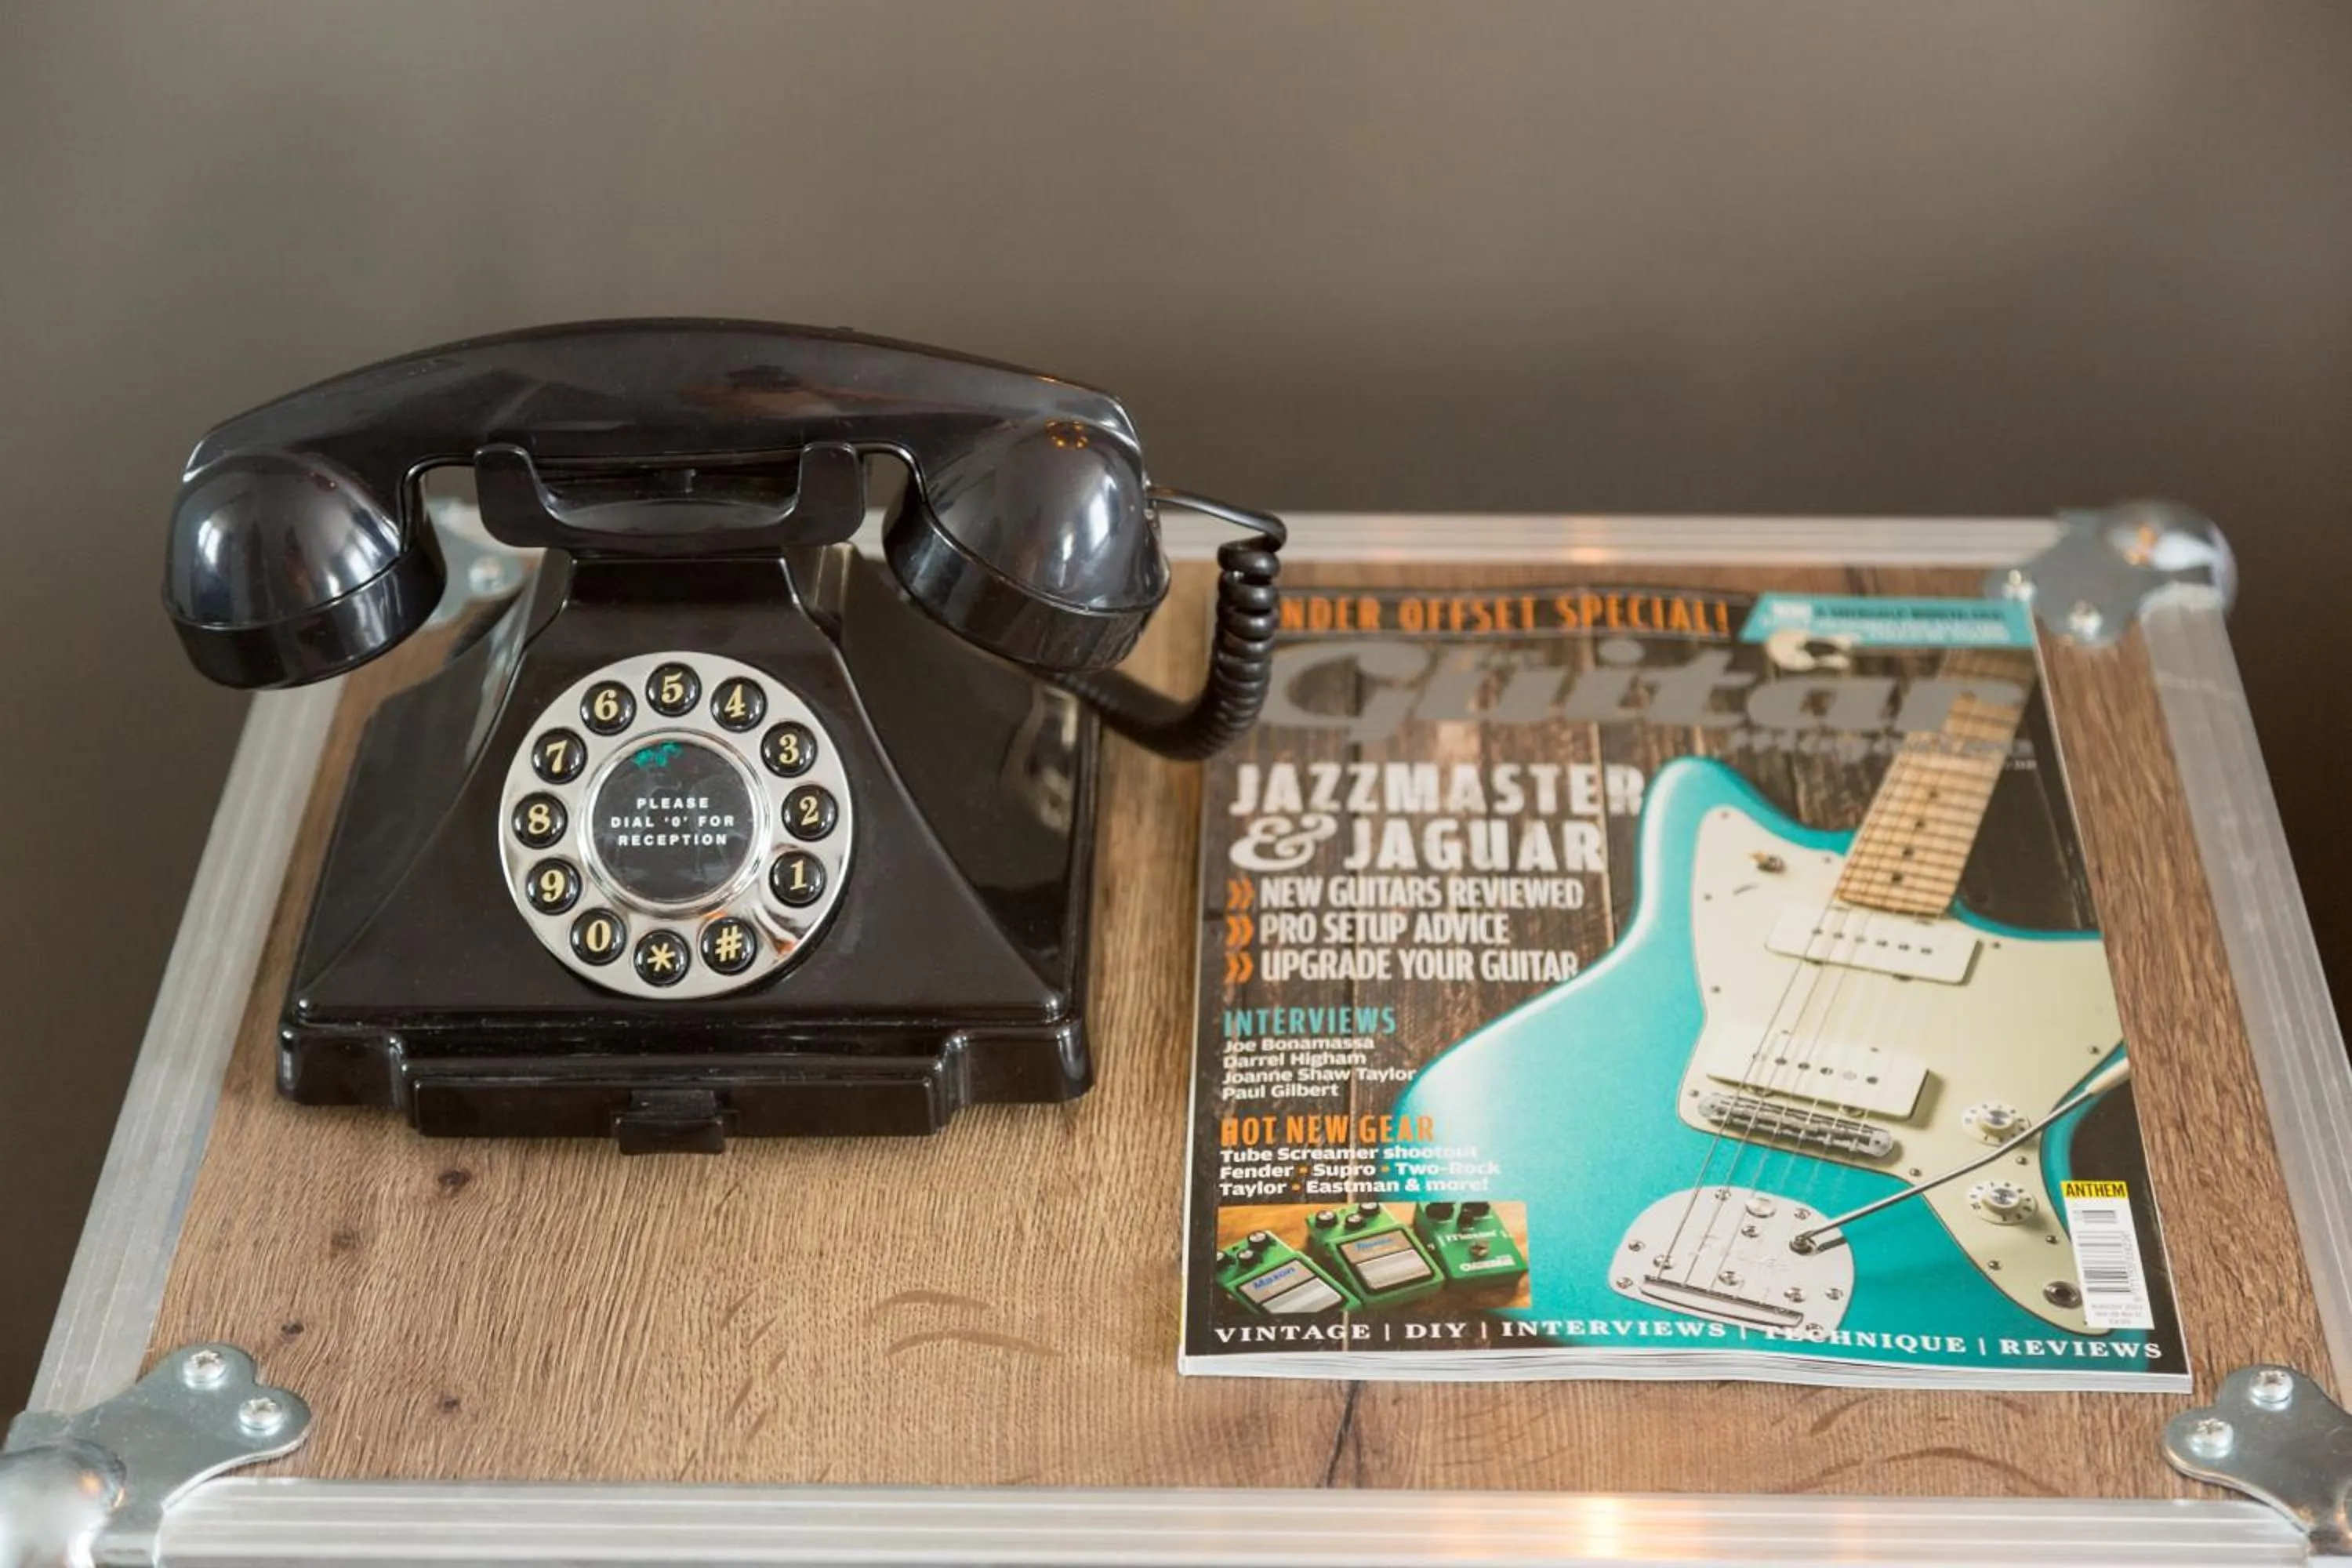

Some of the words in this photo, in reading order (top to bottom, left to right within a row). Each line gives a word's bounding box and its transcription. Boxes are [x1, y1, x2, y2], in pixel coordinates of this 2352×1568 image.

[1279, 596, 1381, 633] NDER
[1398, 596, 1538, 633] OFFSET
[1555, 593, 1730, 637] SPECIAL!
[662, 673, 684, 703] 5
[724, 684, 745, 718] 4
[594, 689, 619, 720] 6
[546, 739, 568, 773] 7
[779, 734, 799, 764] 3
[637, 797, 709, 809] PLEASE
[1229, 763, 1645, 816] JAZZMASTER
[528, 804, 551, 835] 8
[611, 816, 654, 828] DIAL
[698, 815, 735, 827] FOR
[799, 796, 819, 826] 2
[618, 834, 727, 846] RECEPTION
[1229, 813, 1338, 871] &
[1343, 818, 1608, 873] JAGUAR
[541, 869, 565, 902] 9
[789, 861, 808, 890] 1
[1259, 877, 1322, 909] NEW
[1328, 877, 1442, 909] GUITARS
[1450, 877, 1584, 909] REVIEWED
[586, 920, 611, 952] 0
[714, 926, 742, 961] #
[1259, 912, 1316, 944] PRO
[1323, 912, 1407, 944] SETUP
[1414, 913, 1509, 944] ADVICE
[1261, 949, 1393, 982] UPGRADE
[1398, 949, 1474, 982] YOUR
[1480, 950, 1578, 982] GUITAR
[1223, 1006, 1396, 1037] INTERVIEWS
[1222, 1054, 1284, 1069] Darrel
[1290, 1052, 1367, 1069] Higham
[1223, 1039, 1257, 1054] Joe
[1261, 1036, 1375, 1051] Bonamassa
[1222, 1069, 1293, 1086] Joanne
[1298, 1068, 1351, 1082] Shaw
[1357, 1067, 1416, 1082] Taylor
[1222, 1086, 1265, 1100] Paul
[1271, 1083, 1339, 1098] Gilbert
[1221, 1115, 1278, 1146] HOT
[1287, 1115, 1349, 1145] NEW
[1359, 1114, 1434, 1143] GEAR
[1220, 1148, 1272, 1163] Tube
[1277, 1146, 1378, 1161] Screamer
[1383, 1145, 1477, 1160] shootout
[1220, 1164, 1294, 1180] Fender
[1311, 1163, 1376, 1179] Supro
[1395, 1160, 1501, 1175] Two-Rock
[1219, 1181, 1287, 1198] Taylor
[1306, 1180, 1399, 1195] Eastman
[1405, 1178, 1420, 1192] &
[1425, 1178, 1488, 1192] more!
[2066, 1183, 2125, 1197] ANTHEM
[1214, 1323, 1371, 1343] VINTAGE
[1405, 1322, 1468, 1339] DIY
[1501, 1319, 1726, 1338] INTERVIEWS
[1764, 1325, 1966, 1354] TECHNIQUE
[1999, 1337, 2162, 1359] REVIEWS
